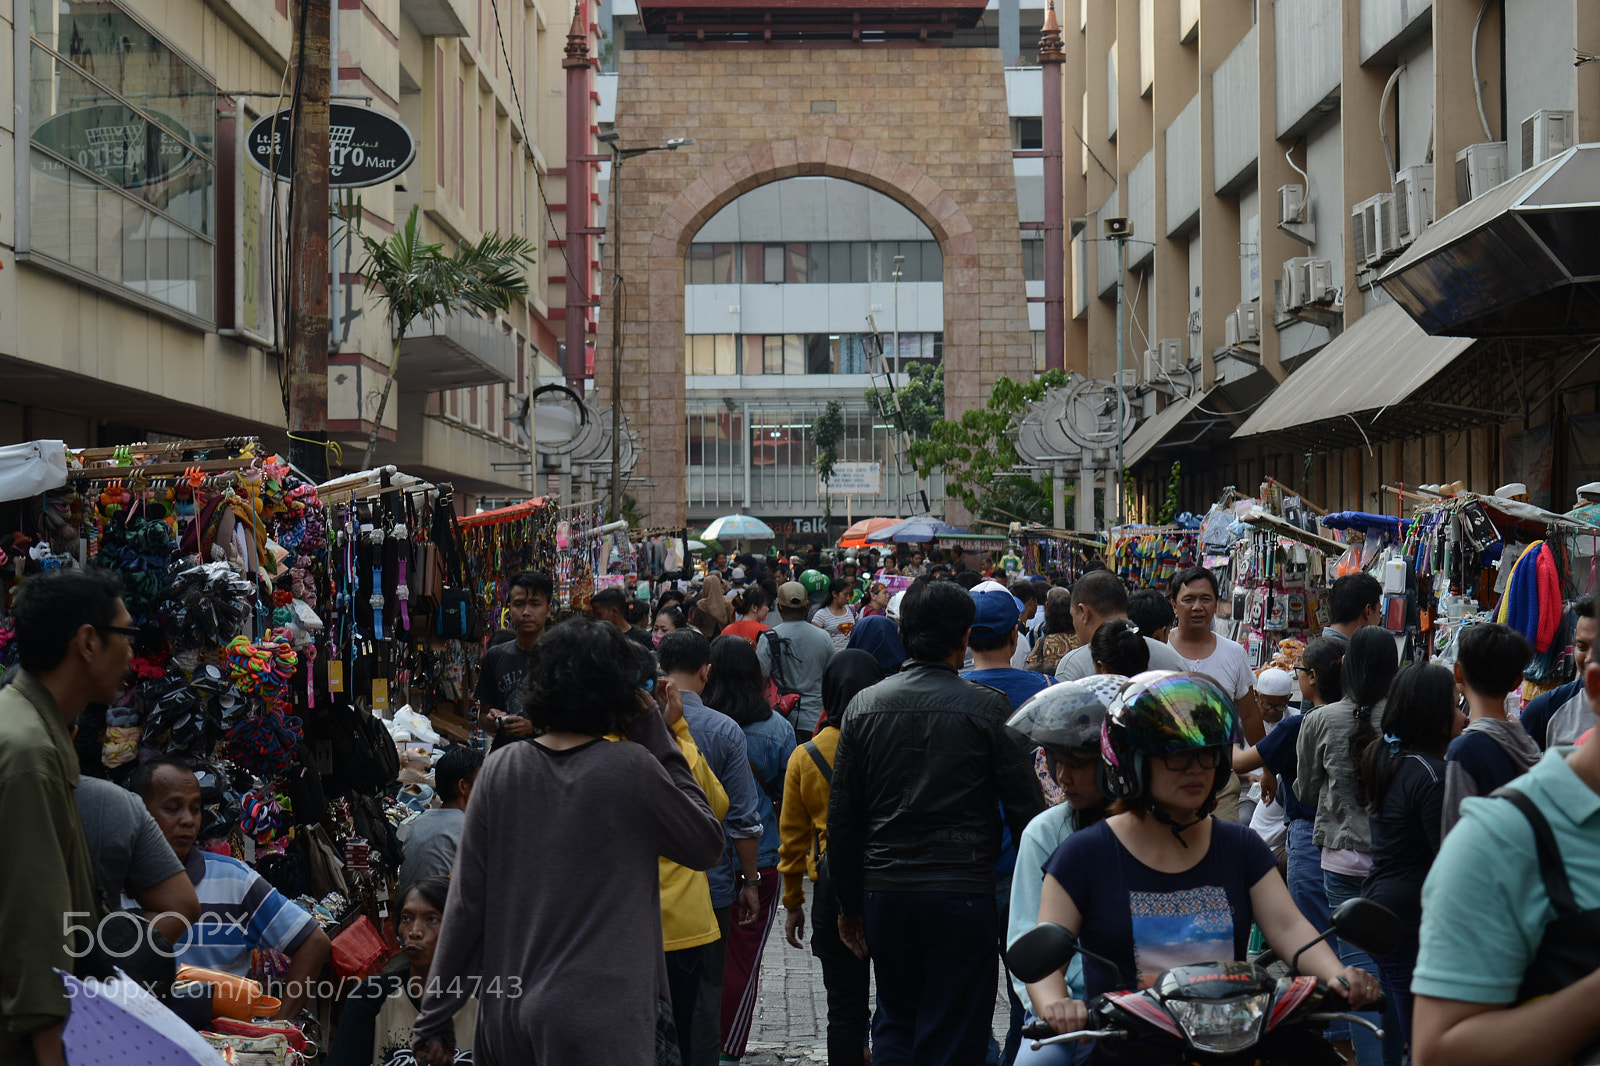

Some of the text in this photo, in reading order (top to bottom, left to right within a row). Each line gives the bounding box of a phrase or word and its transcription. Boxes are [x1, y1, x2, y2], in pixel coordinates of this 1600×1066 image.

[257, 145, 281, 155] ext
[329, 142, 365, 167] tro
[365, 156, 397, 168] Mart
[1188, 973, 1250, 983] YAMAHA
